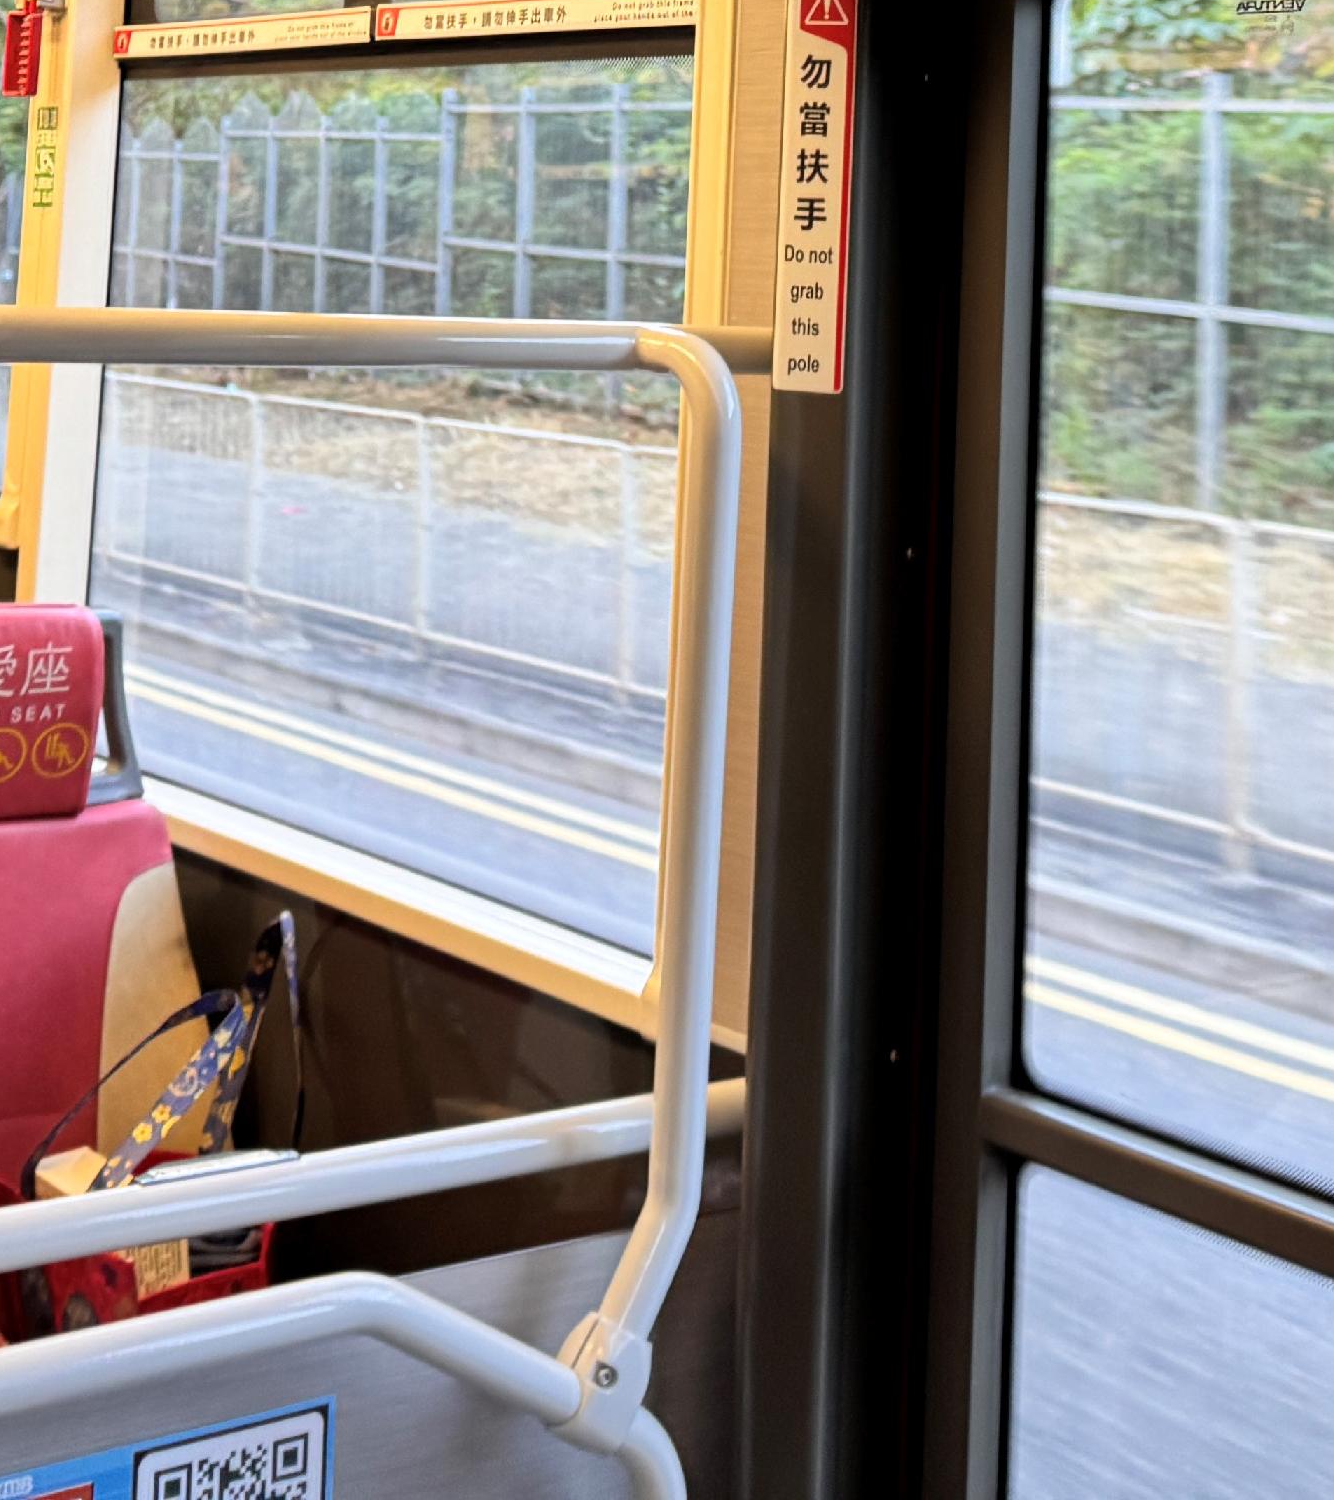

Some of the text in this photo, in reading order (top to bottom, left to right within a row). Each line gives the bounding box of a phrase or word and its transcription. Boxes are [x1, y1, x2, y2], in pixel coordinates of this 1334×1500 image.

[793, 54, 832, 232] 勿當扶手
[784, 244, 834, 265] Do not
[790, 282, 824, 303] grab
[792, 318, 819, 337] this
[787, 353, 819, 376] pole
[11, 704, 66, 724] SEAT
